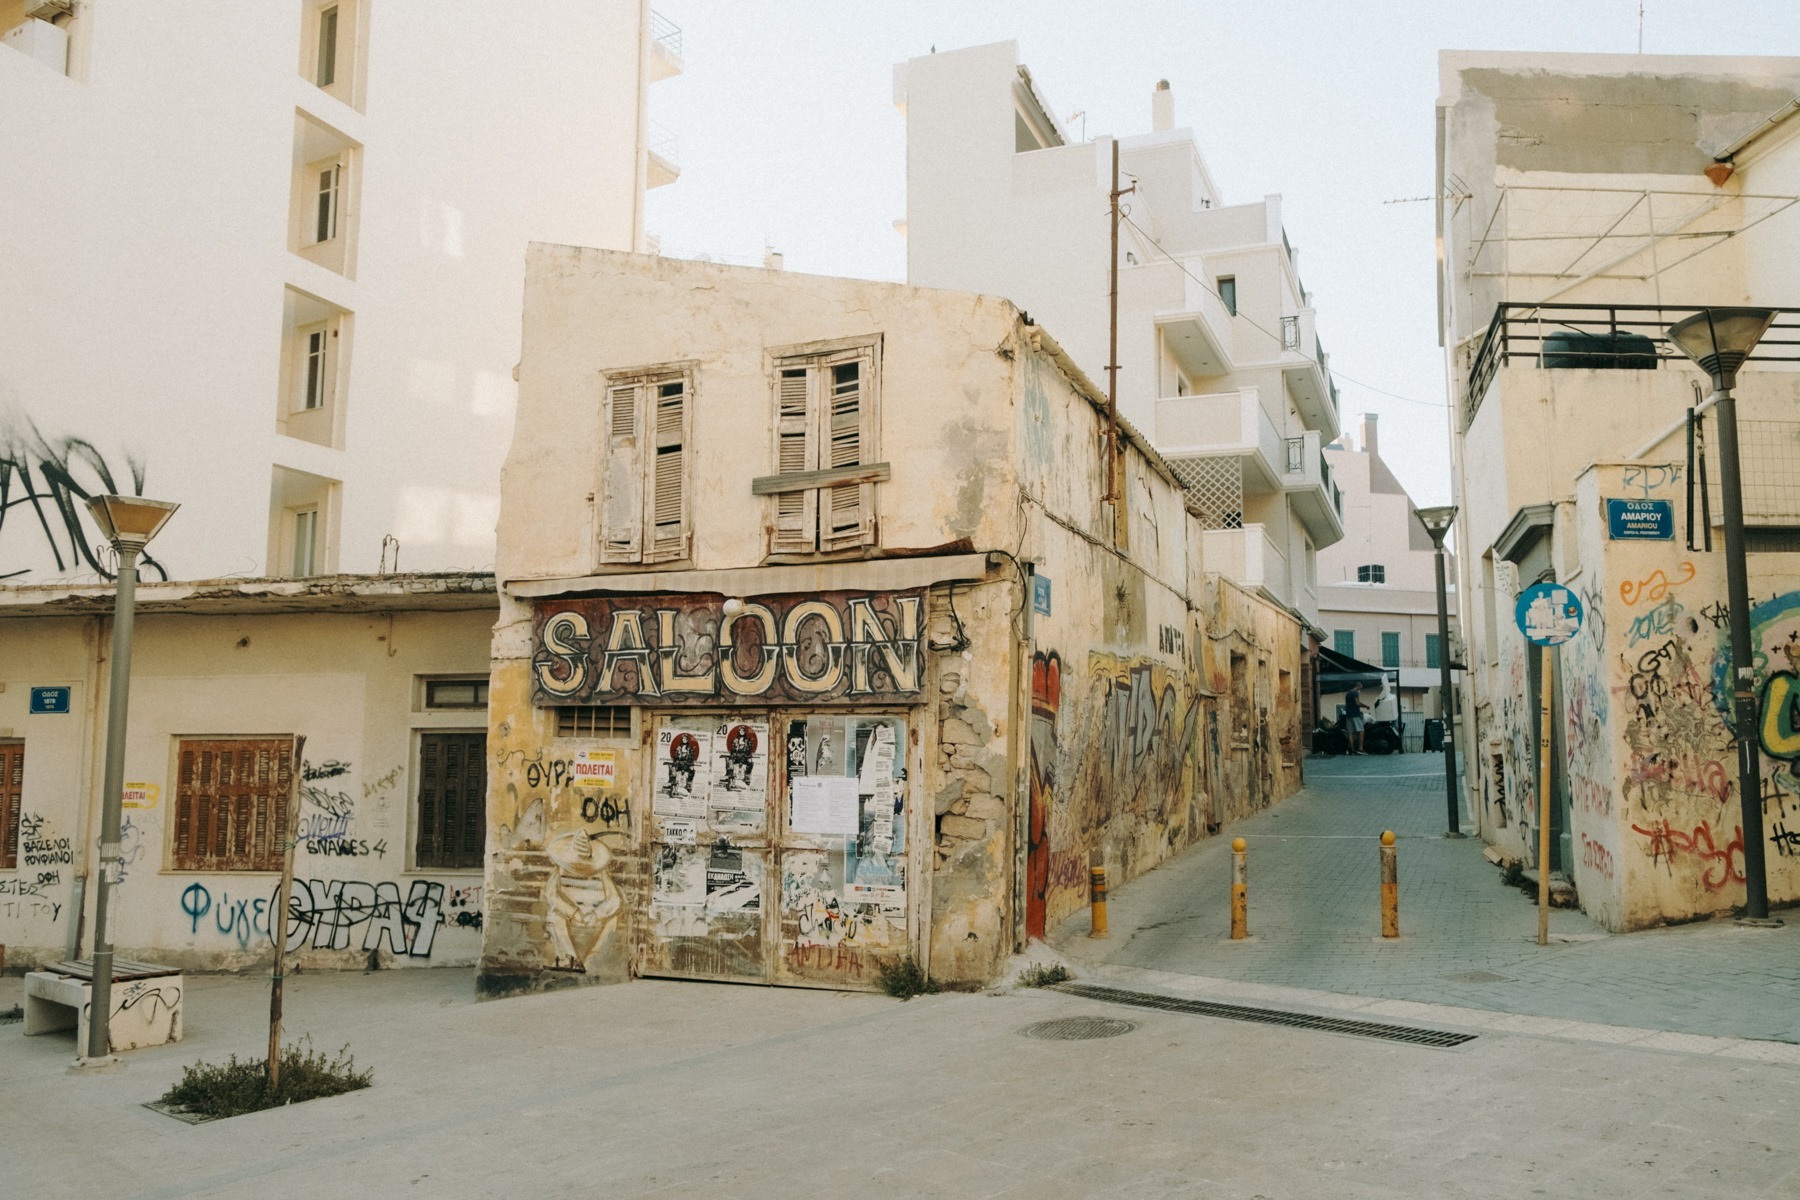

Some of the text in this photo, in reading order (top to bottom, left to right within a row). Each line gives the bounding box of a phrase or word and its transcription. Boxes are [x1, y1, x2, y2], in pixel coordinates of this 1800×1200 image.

[1627, 502, 1654, 510] ΟΔΟΣ
[1621, 512, 1662, 521] ΑΜΑΡΙΟΥ
[534, 597, 921, 698] SALOON
[716, 724, 728, 735] 20
[660, 732, 672, 742] 20
[576, 763, 613, 776] ΠΩΛΕΙΤΑΙ
[581, 797, 632, 829] ΟΦΗ
[37, 870, 60, 885] ΟΦΗ
